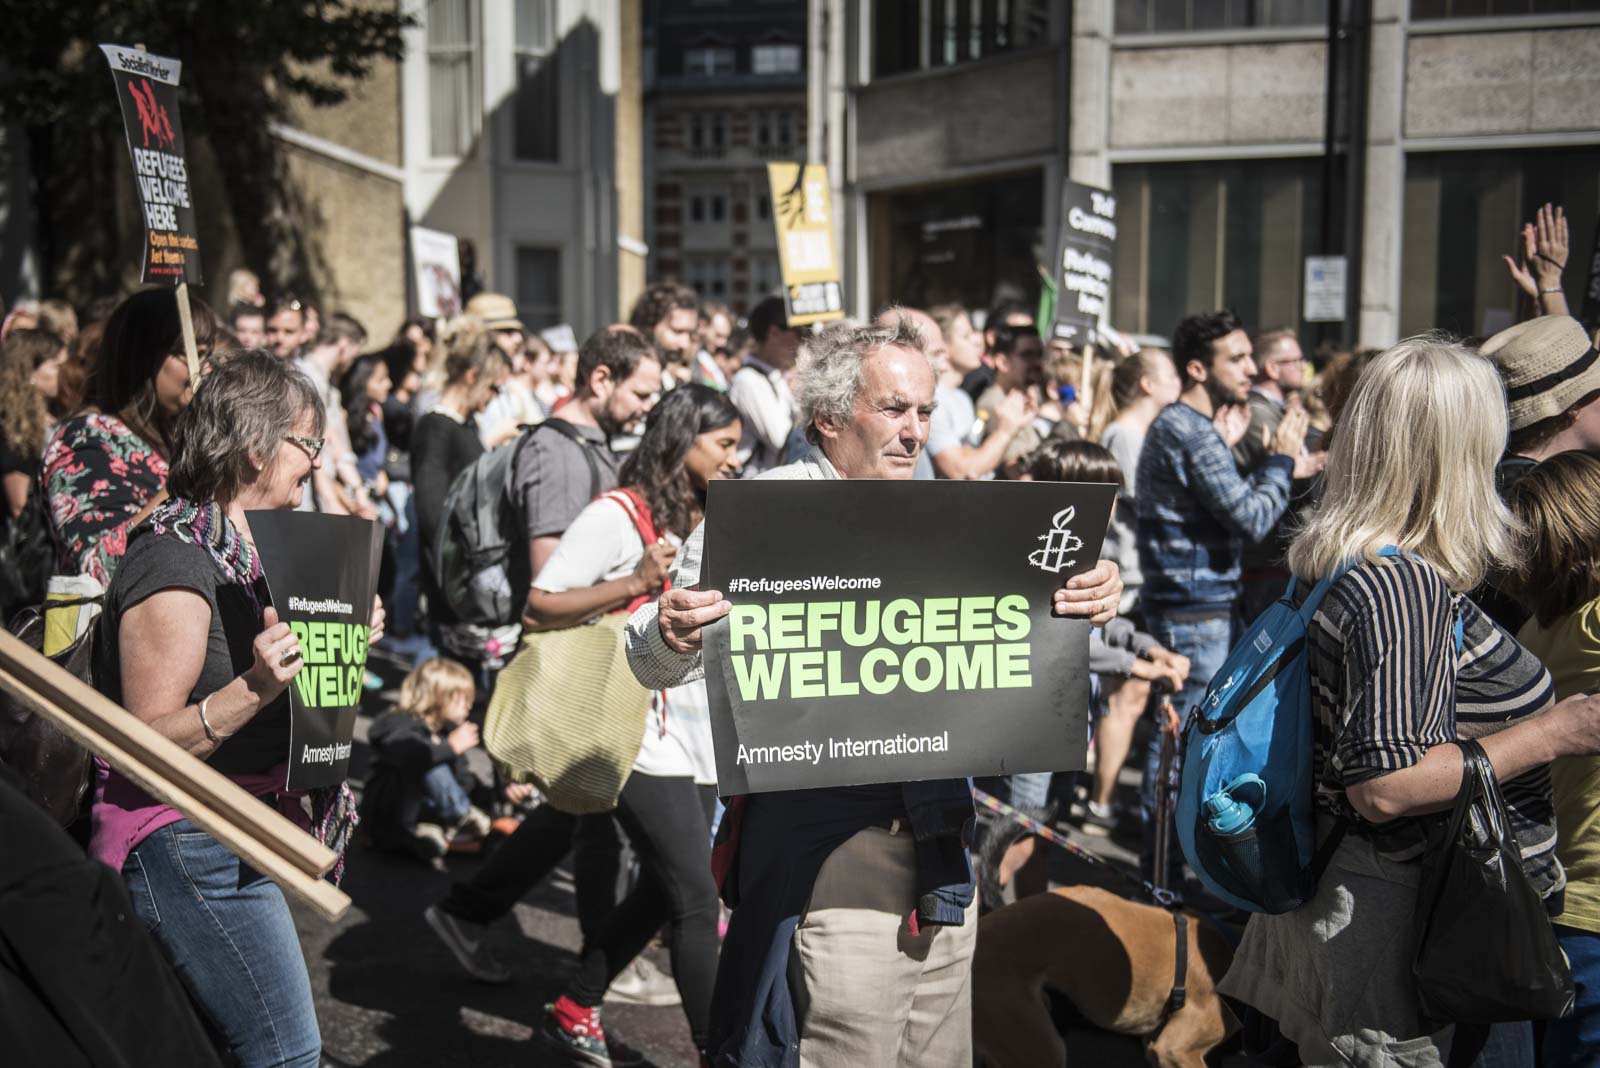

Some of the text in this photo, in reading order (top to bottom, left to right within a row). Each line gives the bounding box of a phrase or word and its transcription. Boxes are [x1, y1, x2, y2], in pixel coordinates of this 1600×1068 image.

[134, 147, 187, 182] REFUGEES
[138, 176, 191, 208] WELCOME
[144, 202, 178, 231] HERE
[728, 576, 882, 594] #RefugeesWelcome
[288, 596, 353, 614] #RefugeesWelcome
[728, 594, 1032, 651] REFUGEES
[290, 621, 370, 664] REFUG
[730, 642, 1033, 701] WELCOME
[301, 743, 335, 766] Amnesty
[736, 731, 949, 765] Amnesty International
